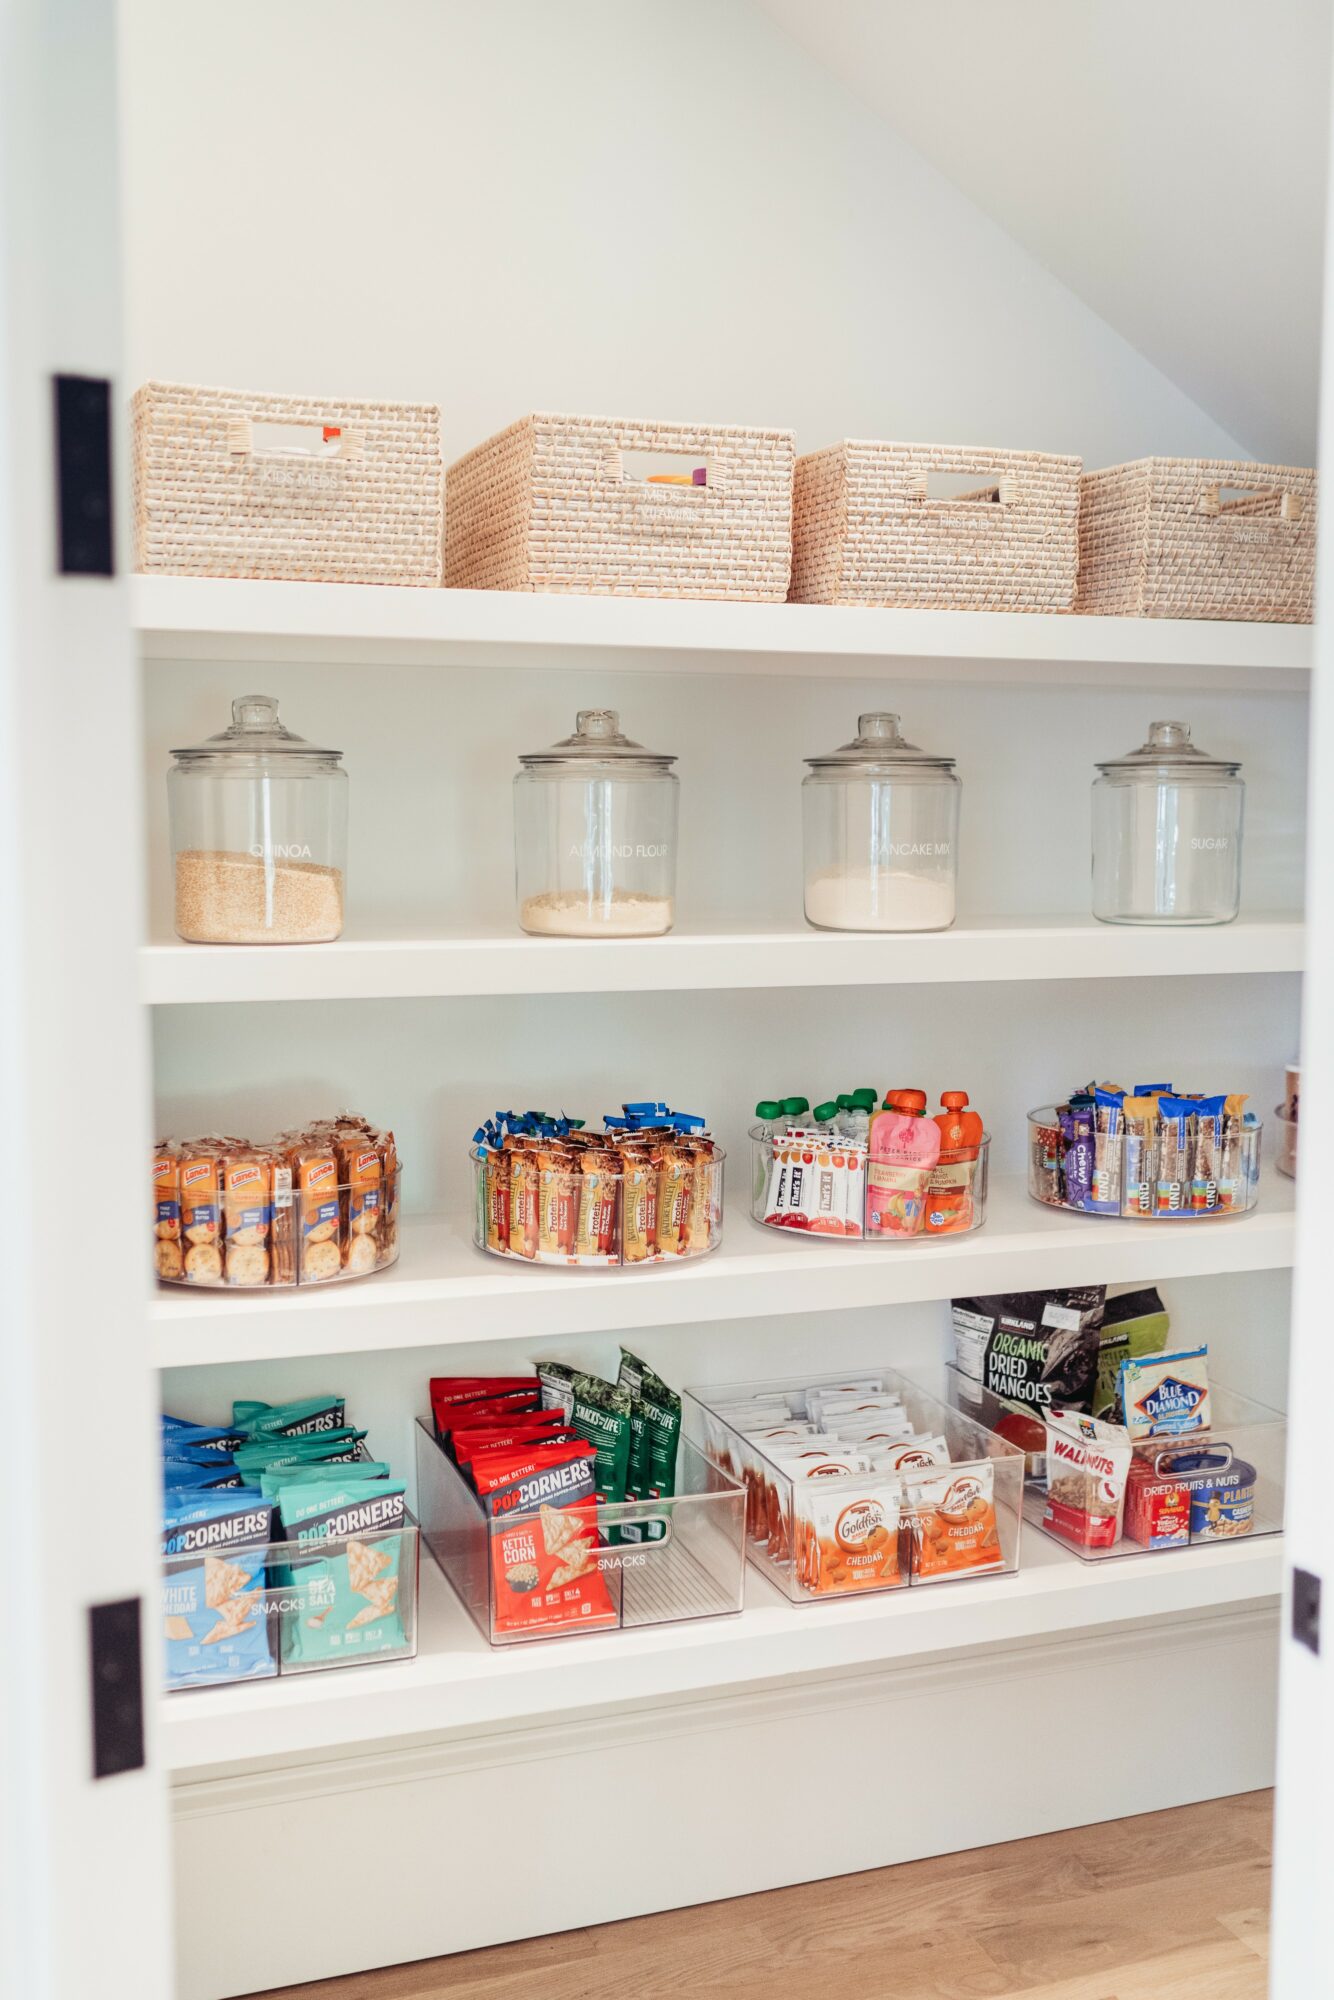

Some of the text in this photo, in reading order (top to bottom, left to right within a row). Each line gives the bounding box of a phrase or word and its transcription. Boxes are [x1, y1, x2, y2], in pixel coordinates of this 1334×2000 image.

[264, 470, 337, 488] KIDS MEDS
[645, 489, 679, 502] MEDS
[940, 515, 989, 530] FIRST AID
[1233, 531, 1269, 543] SWEETS
[251, 844, 311, 858] QINOA
[879, 843, 933, 856] ANCAKE
[1191, 838, 1229, 850] SUGAR
[309, 1164, 333, 1182] Lance
[1077, 1144, 1088, 1185] Chewy
[185, 1167, 209, 1181] Lance
[231, 1170, 259, 1185] Lance
[791, 1180, 801, 1206] That's
[1098, 1171, 1109, 1202] KIND
[821, 1184, 830, 1209] That's
[550, 1196, 558, 1233] Protein
[638, 1196, 646, 1233] Protein
[672, 1191, 683, 1228] Protein
[590, 1201, 602, 1237] Protein
[992, 1332, 1048, 1363] ORGANIC
[989, 1352, 1028, 1380] DRIED
[989, 1372, 1053, 1405] MANGOES
[1159, 1384, 1183, 1400] BLUE
[1146, 1391, 1200, 1416] DIAMOND
[575, 1404, 619, 1434] SNACKS LIFE
[1054, 1440, 1114, 1476] WALNUTS
[489, 1463, 535, 1488] DO ONE BETTER!
[492, 1459, 591, 1515] POPCORNERS
[1144, 1475, 1240, 1498] DRIED FRUITS & NUTS
[297, 1495, 404, 1549] POPCORNERS
[841, 1512, 882, 1539] Goldfish
[896, 1515, 933, 1531] NACKS
[947, 1522, 985, 1537] CHEDDAR
[502, 1535, 535, 1551] KETTLE
[503, 1547, 537, 1565] CORN
[597, 1554, 646, 1571] SNACKS
[846, 1551, 884, 1567] CHEDDAR
[308, 1577, 336, 1594] SEA
[251, 1598, 305, 1616] SNACKS
[308, 1593, 336, 1608] SALT
